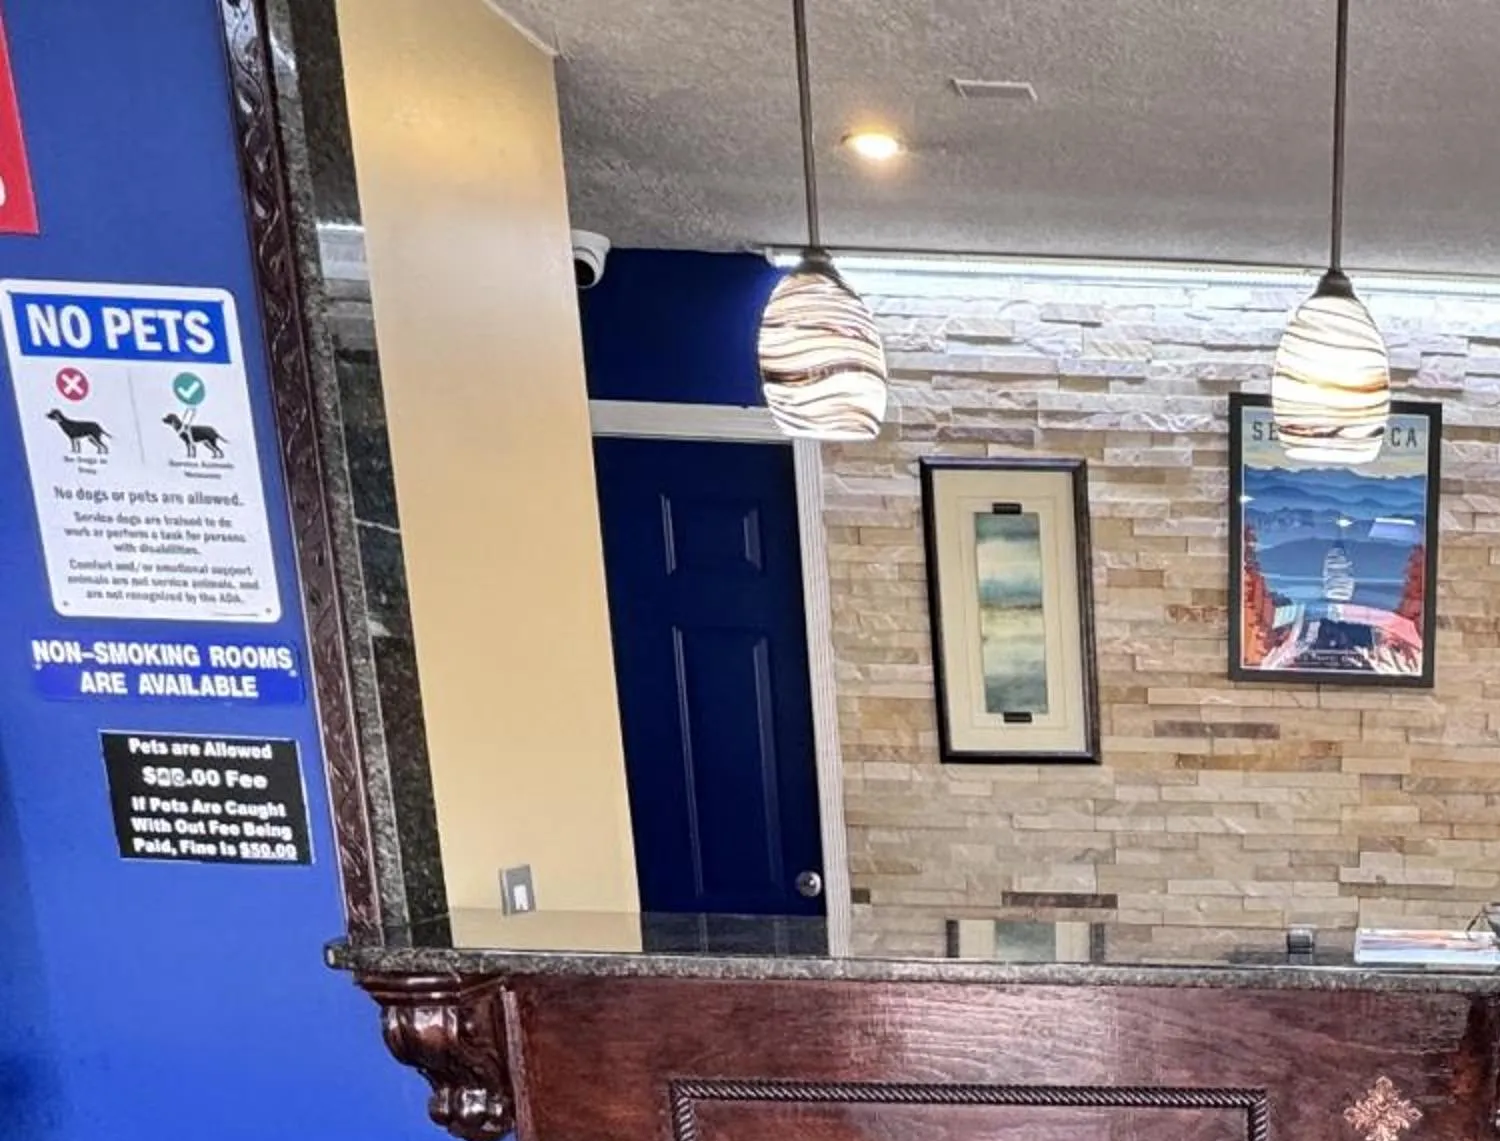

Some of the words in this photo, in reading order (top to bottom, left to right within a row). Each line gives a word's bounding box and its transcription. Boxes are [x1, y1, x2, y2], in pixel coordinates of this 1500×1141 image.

[25, 303, 92, 349] NO
[101, 306, 215, 354] PETS
[31, 640, 201, 668] NON-SMOKING
[208, 645, 294, 670] ROOMS
[80, 671, 129, 695] ARE
[138, 673, 259, 698] AVAILABLE
[127, 737, 169, 755] Pets
[171, 741, 201, 757] are
[203, 741, 273, 760] Allowed
[224, 769, 268, 790] Fee
[131, 796, 147, 812] If
[149, 797, 189, 814] Pets
[191, 798, 222, 815] Are
[224, 800, 287, 820] Caught
[130, 817, 173, 834] With
[174, 819, 206, 835] Out
[208, 819, 241, 837] Fee
[242, 821, 293, 841] Being
[179, 839, 217, 856] Fine
